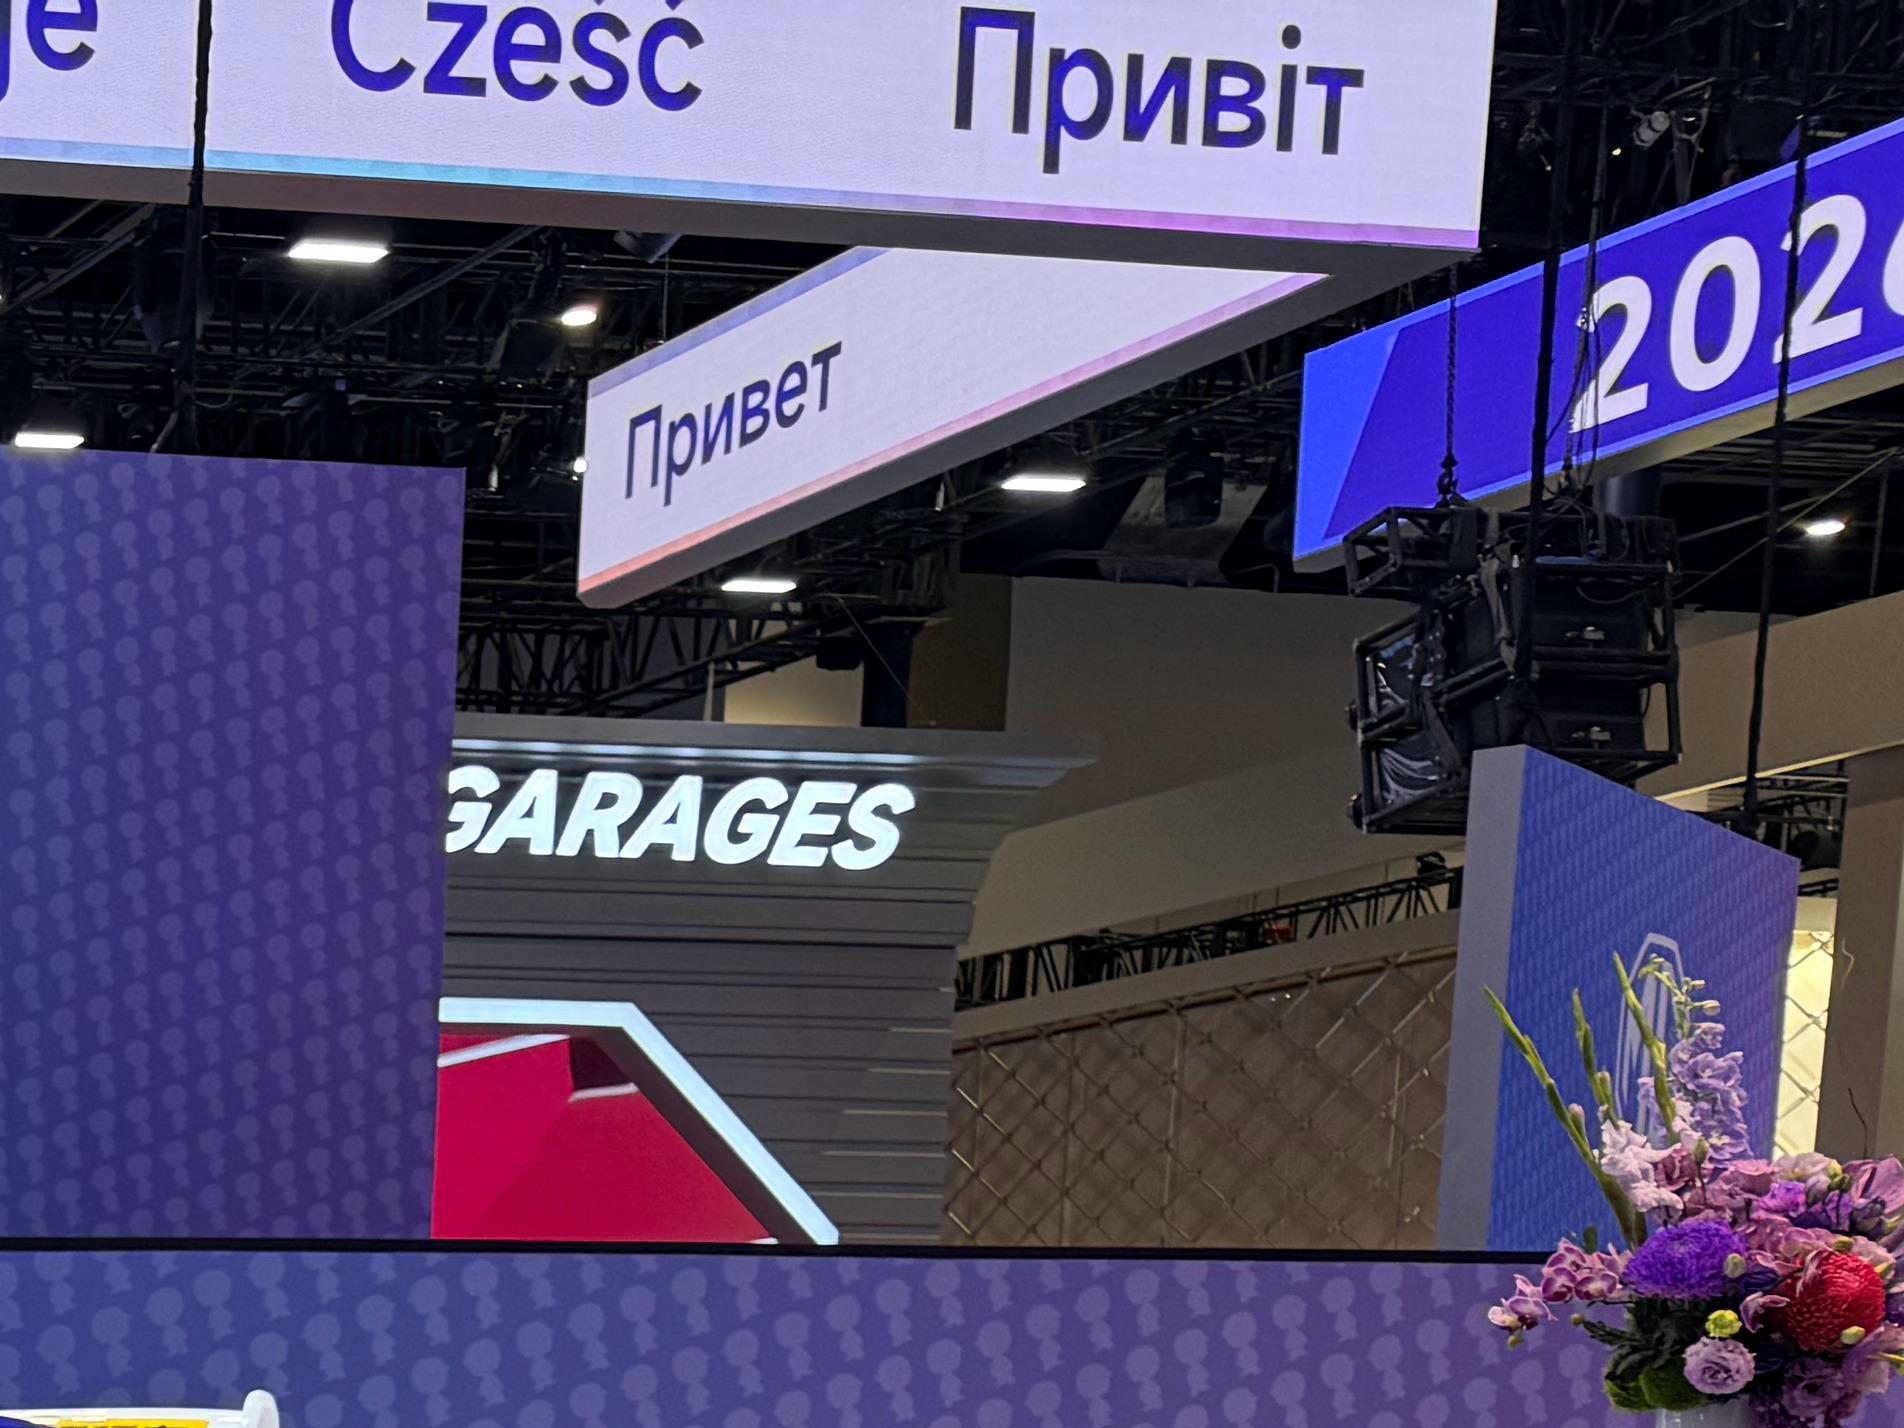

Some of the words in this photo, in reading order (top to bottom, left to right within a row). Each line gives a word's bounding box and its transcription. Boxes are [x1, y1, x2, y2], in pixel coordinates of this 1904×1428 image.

[954, 6, 1364, 174] Привіт
[1568, 194, 1904, 434] 202
[625, 341, 842, 507] Привет
[446, 765, 916, 870] GARAGES
